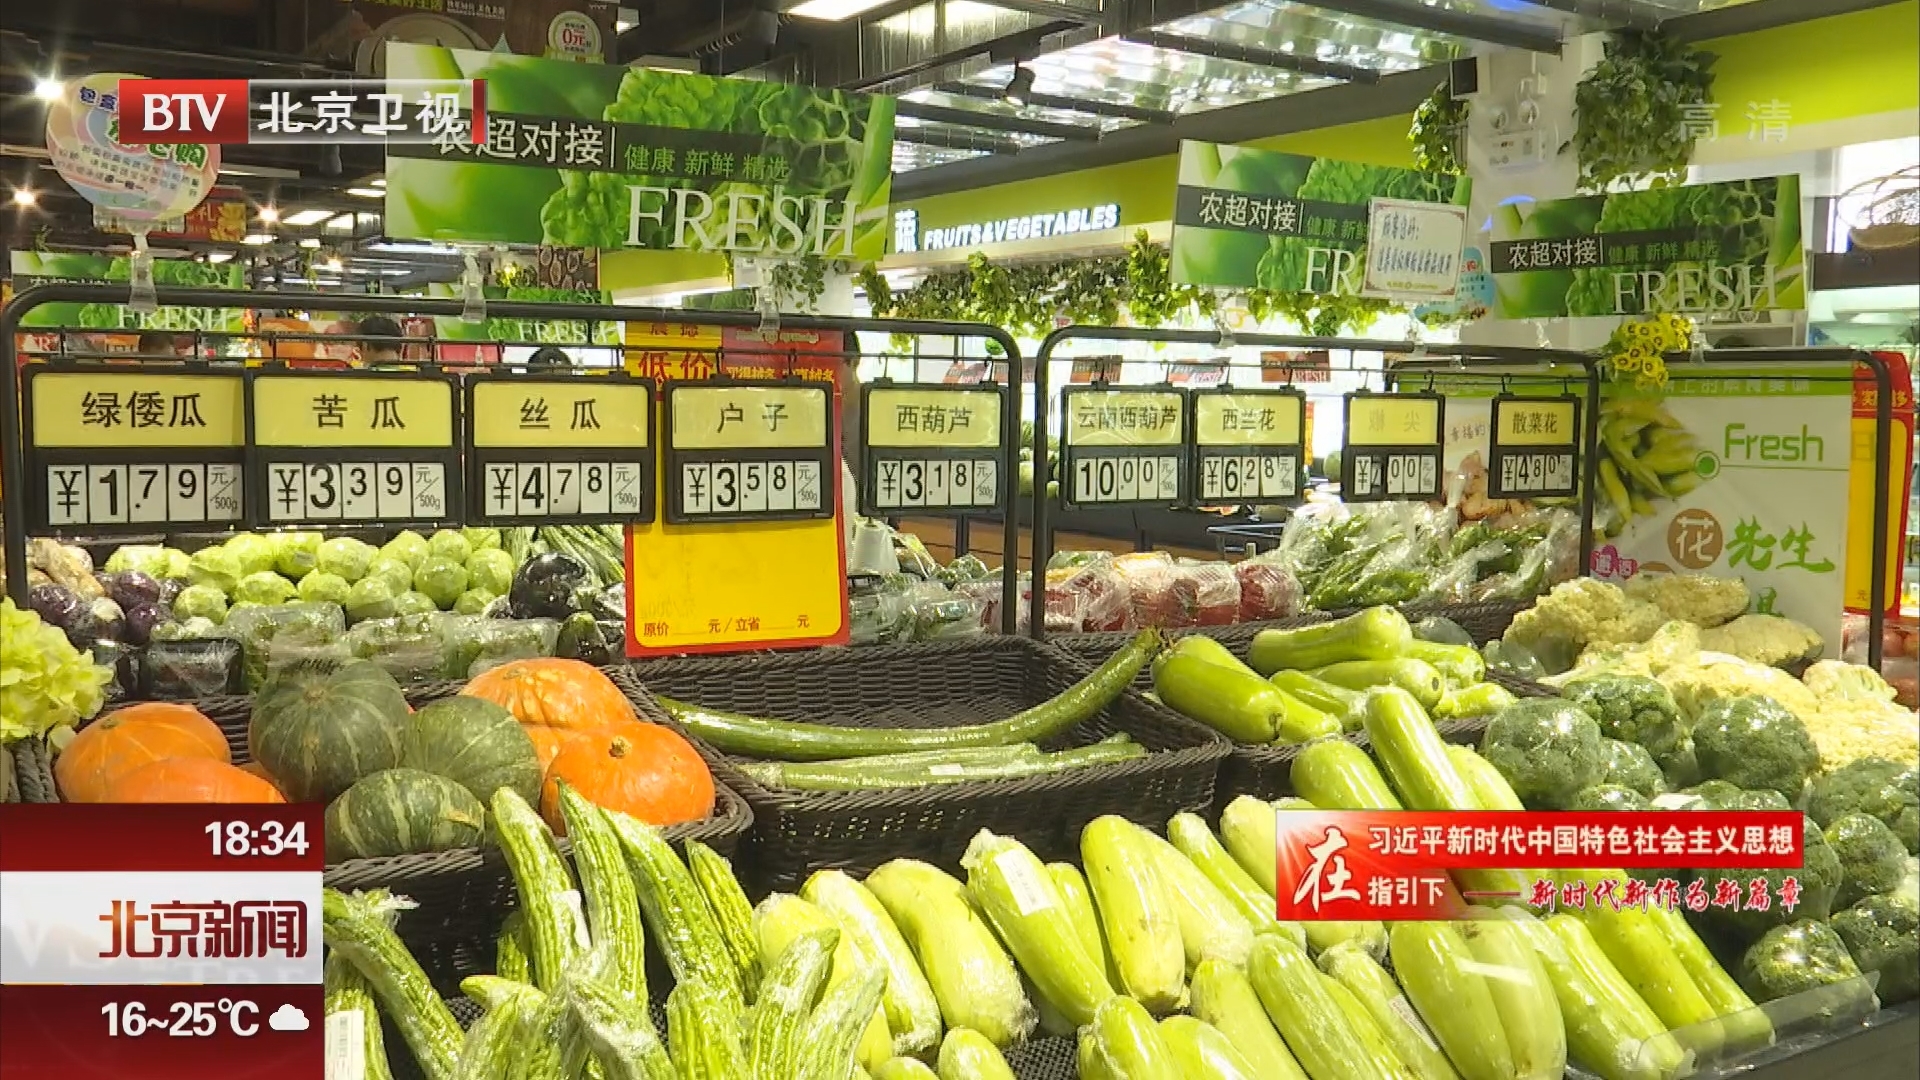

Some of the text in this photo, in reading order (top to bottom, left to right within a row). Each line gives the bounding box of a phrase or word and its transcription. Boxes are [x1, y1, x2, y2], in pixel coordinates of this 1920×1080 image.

[624, 143, 676, 174] 健康
[684, 149, 734, 178] 新鲜
[742, 154, 792, 182] 精选
[622, 184, 862, 257] FRESH
[923, 203, 1121, 251] FRUITS&VEGETABLES
[1199, 191, 1297, 233] 农超对接
[1508, 237, 1598, 270] 农超对接
[1610, 262, 1780, 315] FRESH
[81, 390, 207, 430] 绿倭瓜
[312, 394, 406, 431] 苦瓜
[519, 397, 601, 431] 丝瓜
[716, 402, 790, 434] 户子
[896, 404, 974, 435] 西葫芦
[1221, 408, 1277, 432] 西兰花
[1512, 410, 1559, 435] 散菜花
[1723, 422, 1825, 463] Fresh
[55, 466, 198, 517] ¥1.79
[276, 464, 404, 513] ¥3.39
[492, 465, 603, 511] ¥4.78
[689, 463, 788, 508] ¥3.58
[881, 462, 967, 502] ¥3.18
[1080, 461, 1155, 497] 10.00
[1206, 460, 1275, 493] ¥6.28
[644, 620, 670, 638] 原价
[797, 614, 811, 629] 元
